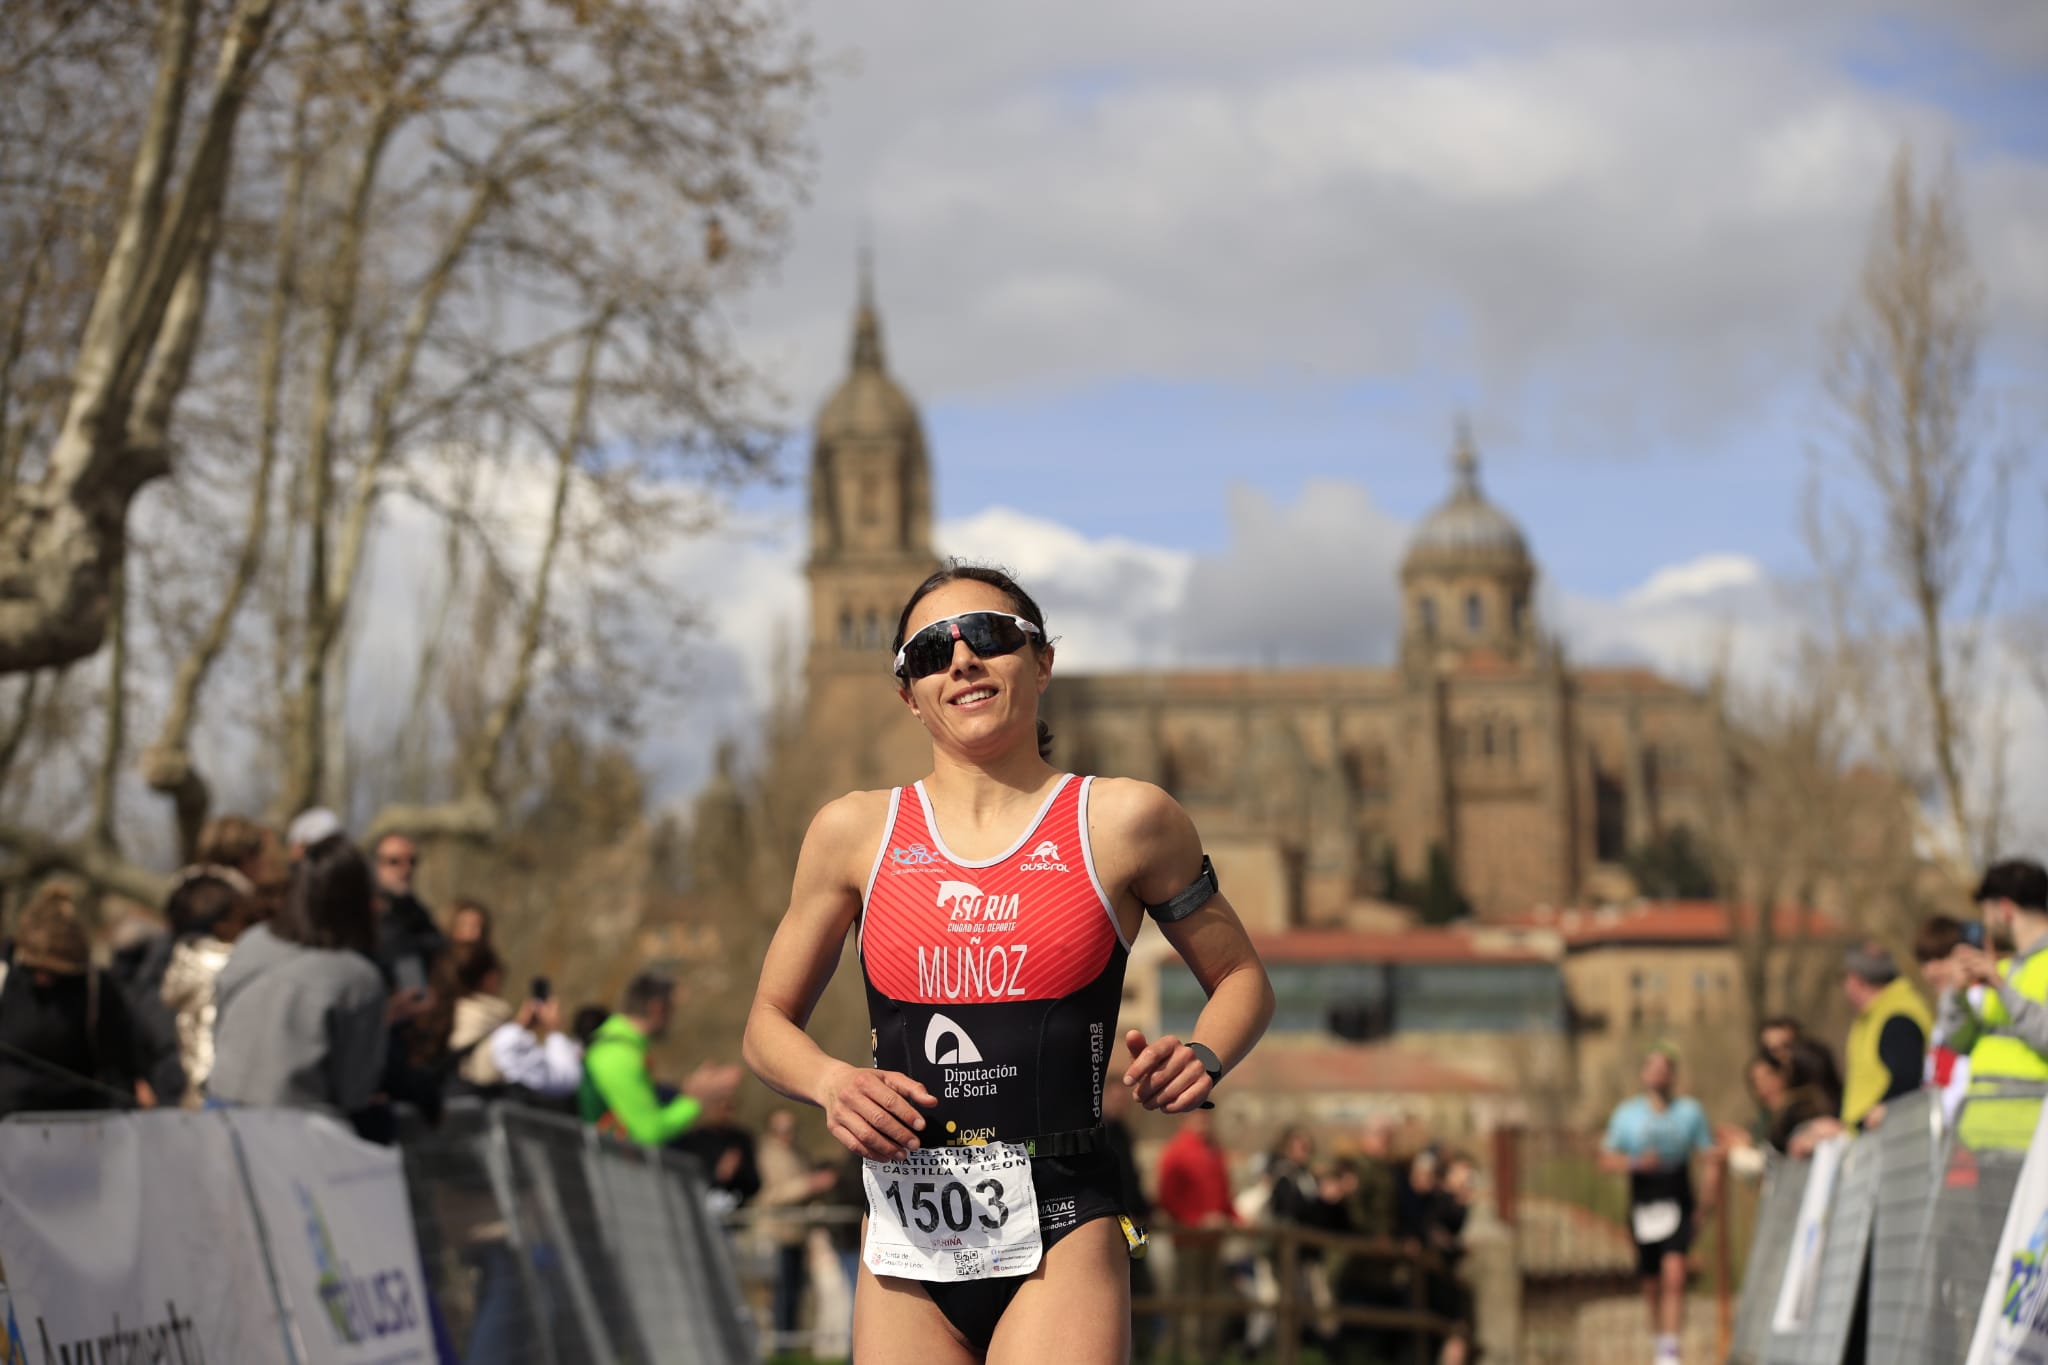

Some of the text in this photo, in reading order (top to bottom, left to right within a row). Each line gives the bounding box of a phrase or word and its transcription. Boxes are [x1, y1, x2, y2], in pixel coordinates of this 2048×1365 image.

[947, 922, 1017, 933] CIUDAD DEL DEPORTE
[918, 936, 1028, 999] MUÑOZ
[944, 1063, 1018, 1086] Diputación
[1089, 1023, 1101, 1118] deporama
[944, 1081, 998, 1098] de Soria
[960, 1127, 996, 1141] JOVEN
[909, 1147, 986, 1157] ERACION
[1004, 1150, 1025, 1158] DE
[882, 1165, 953, 1176] CASTILLA
[962, 1167, 971, 1175] Y
[885, 1177, 1009, 1233] 1503
